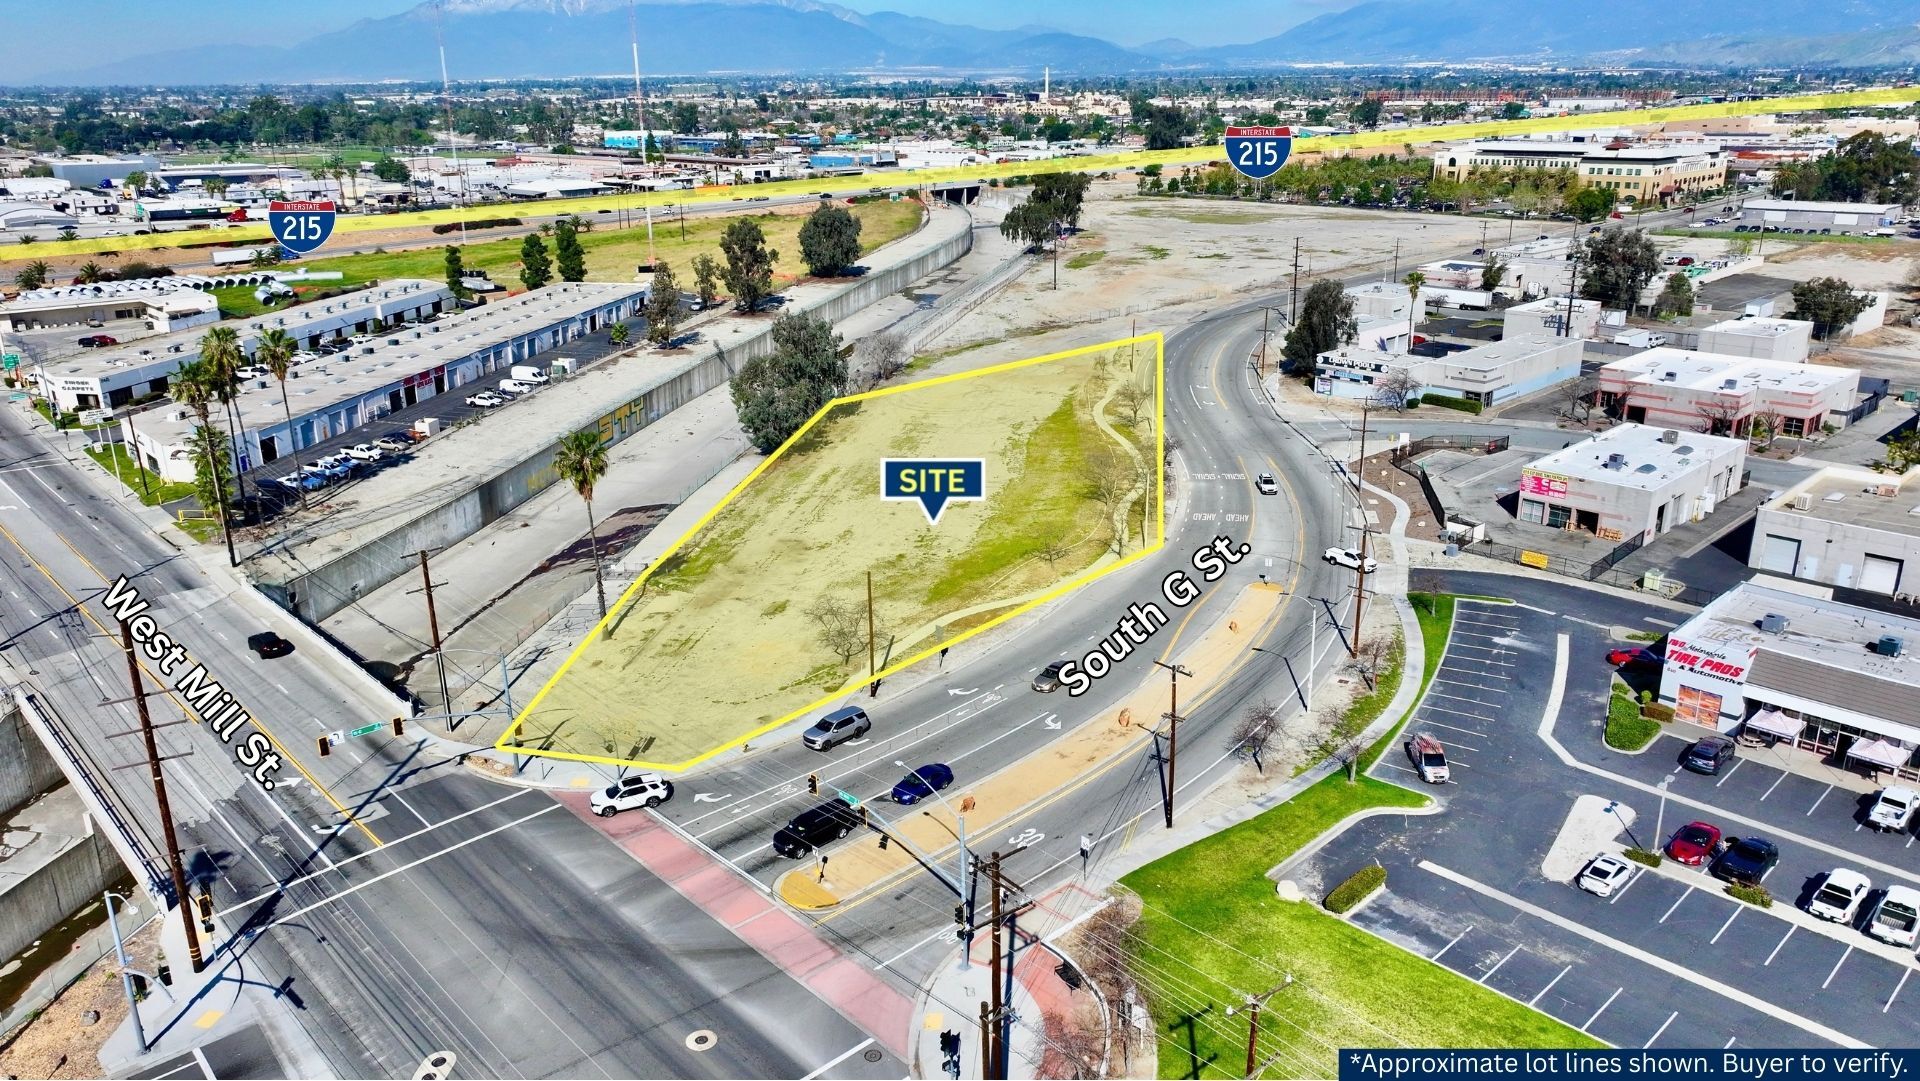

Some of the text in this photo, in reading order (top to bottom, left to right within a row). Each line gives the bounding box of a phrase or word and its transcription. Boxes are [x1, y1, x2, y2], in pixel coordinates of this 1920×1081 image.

[1353, 360, 1376, 369] POOLS
[1192, 513, 1217, 521] AHEAD
[1225, 513, 1250, 522] AHEAD
[1667, 650, 1744, 678] TIRE PROS
[1688, 667, 1744, 686] Automotive
